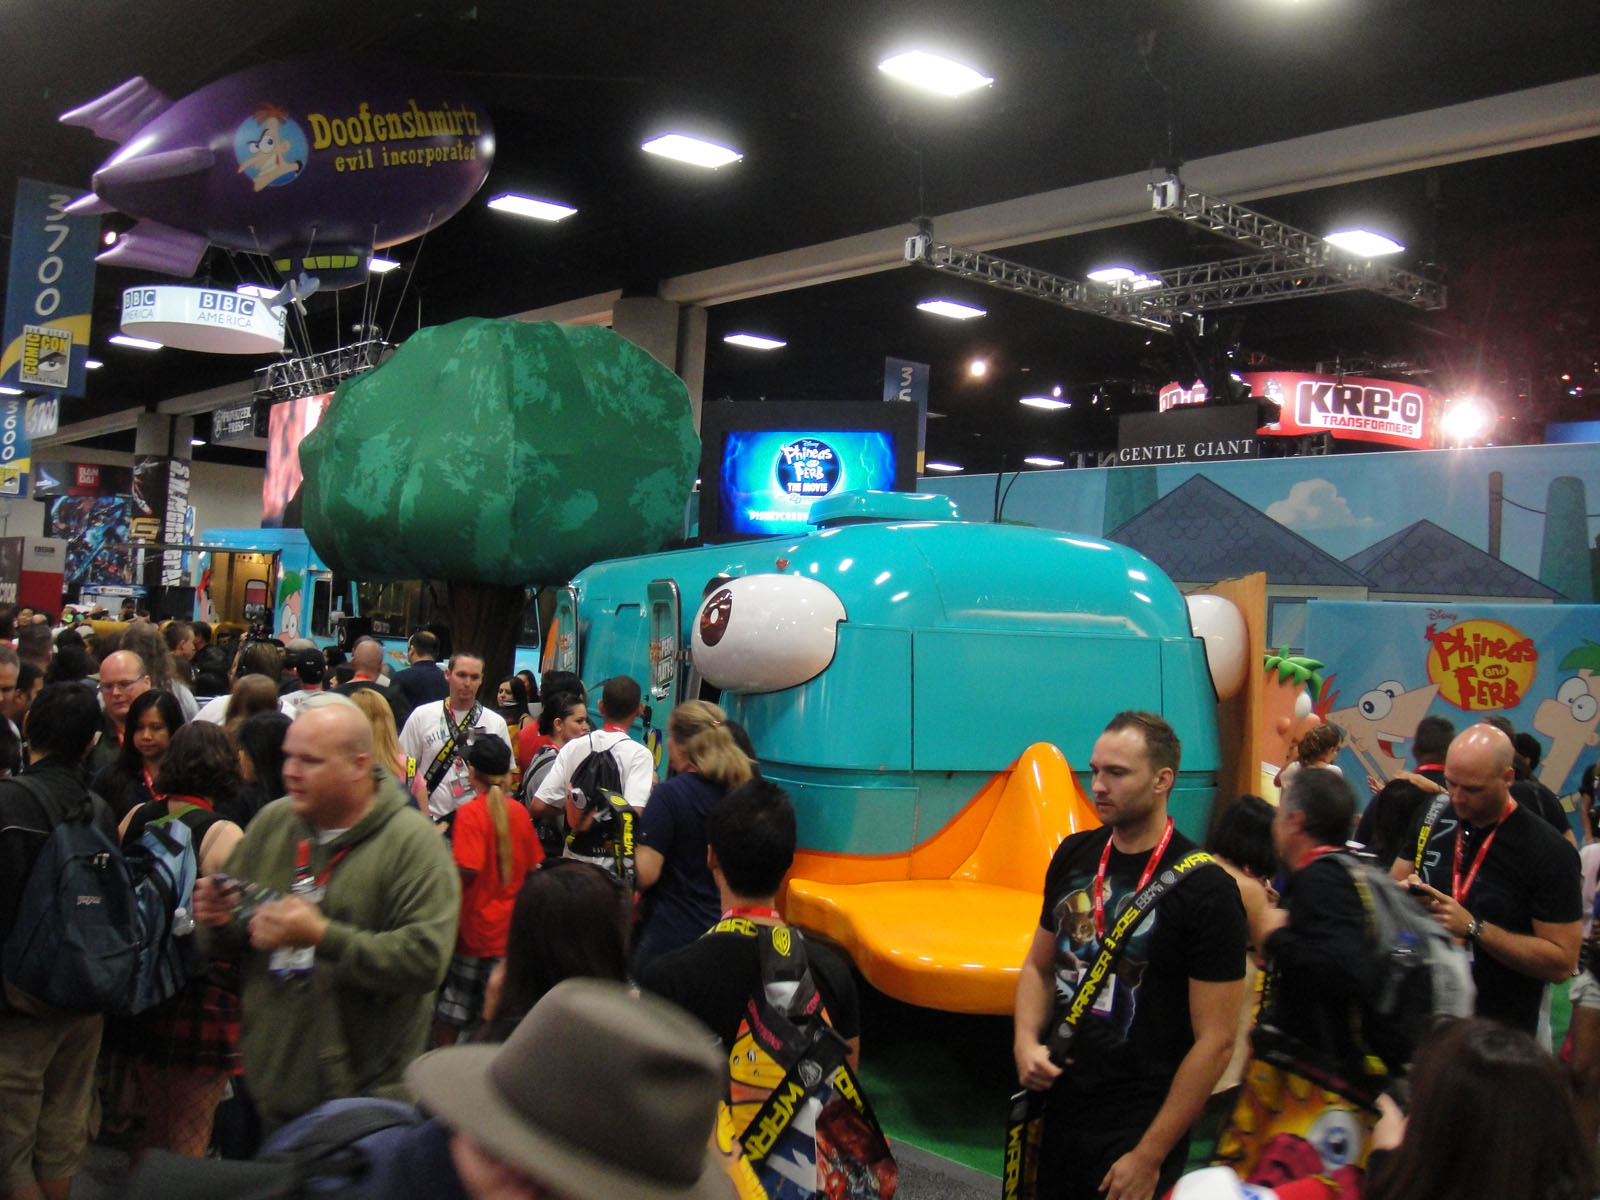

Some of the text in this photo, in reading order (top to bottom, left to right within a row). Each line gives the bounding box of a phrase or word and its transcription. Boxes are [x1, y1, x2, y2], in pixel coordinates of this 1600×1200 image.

[307, 98, 481, 150] Doofenshmirtz
[335, 140, 476, 172] evil incorporated
[35, 194, 71, 316] 3700
[124, 289, 156, 310] BBC
[199, 291, 256, 317] BBC
[197, 311, 253, 329] AMERICA
[23, 332, 41, 376] COMIC
[41, 334, 68, 353] CON
[2, 400, 20, 461] 3600
[1322, 415, 1414, 435] TRANSFORMERS
[780, 443, 833, 465] Phineas
[1119, 439, 1253, 462] GENTLE GIANT
[793, 461, 825, 482] FERB
[787, 482, 828, 493] THE MOVIE
[1424, 623, 1538, 672] Phineas
[1482, 664, 1509, 679] and
[1452, 664, 1521, 712] FERB
[1065, 951, 1113, 1025] WARNER
